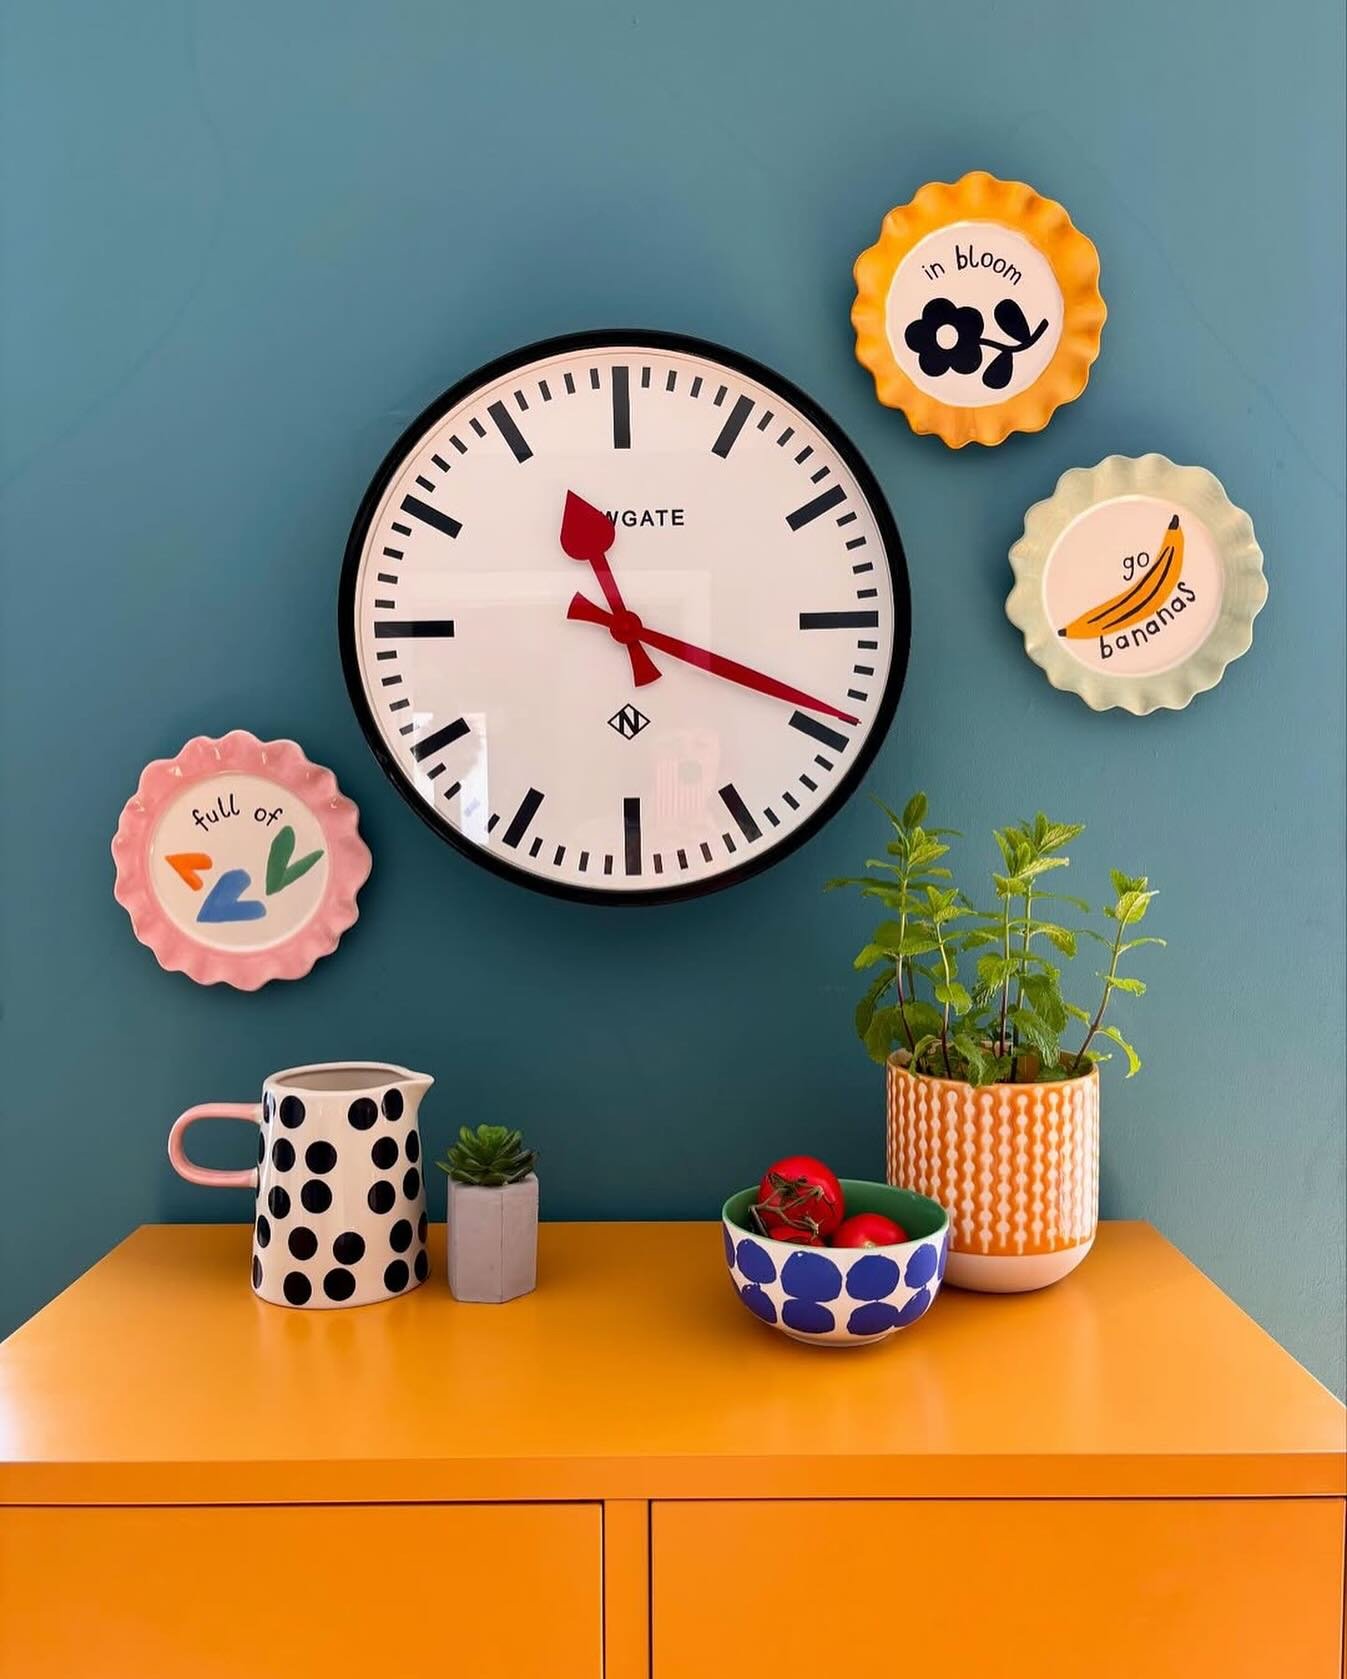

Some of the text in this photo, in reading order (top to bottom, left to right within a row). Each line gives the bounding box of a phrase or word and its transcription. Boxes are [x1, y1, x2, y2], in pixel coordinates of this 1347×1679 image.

[921, 244, 1022, 285] in bloom
[605, 509, 685, 527] WGATE
[1123, 552, 1150, 581] go
[1100, 581, 1196, 659] bananas
[192, 793, 283, 832] full of
